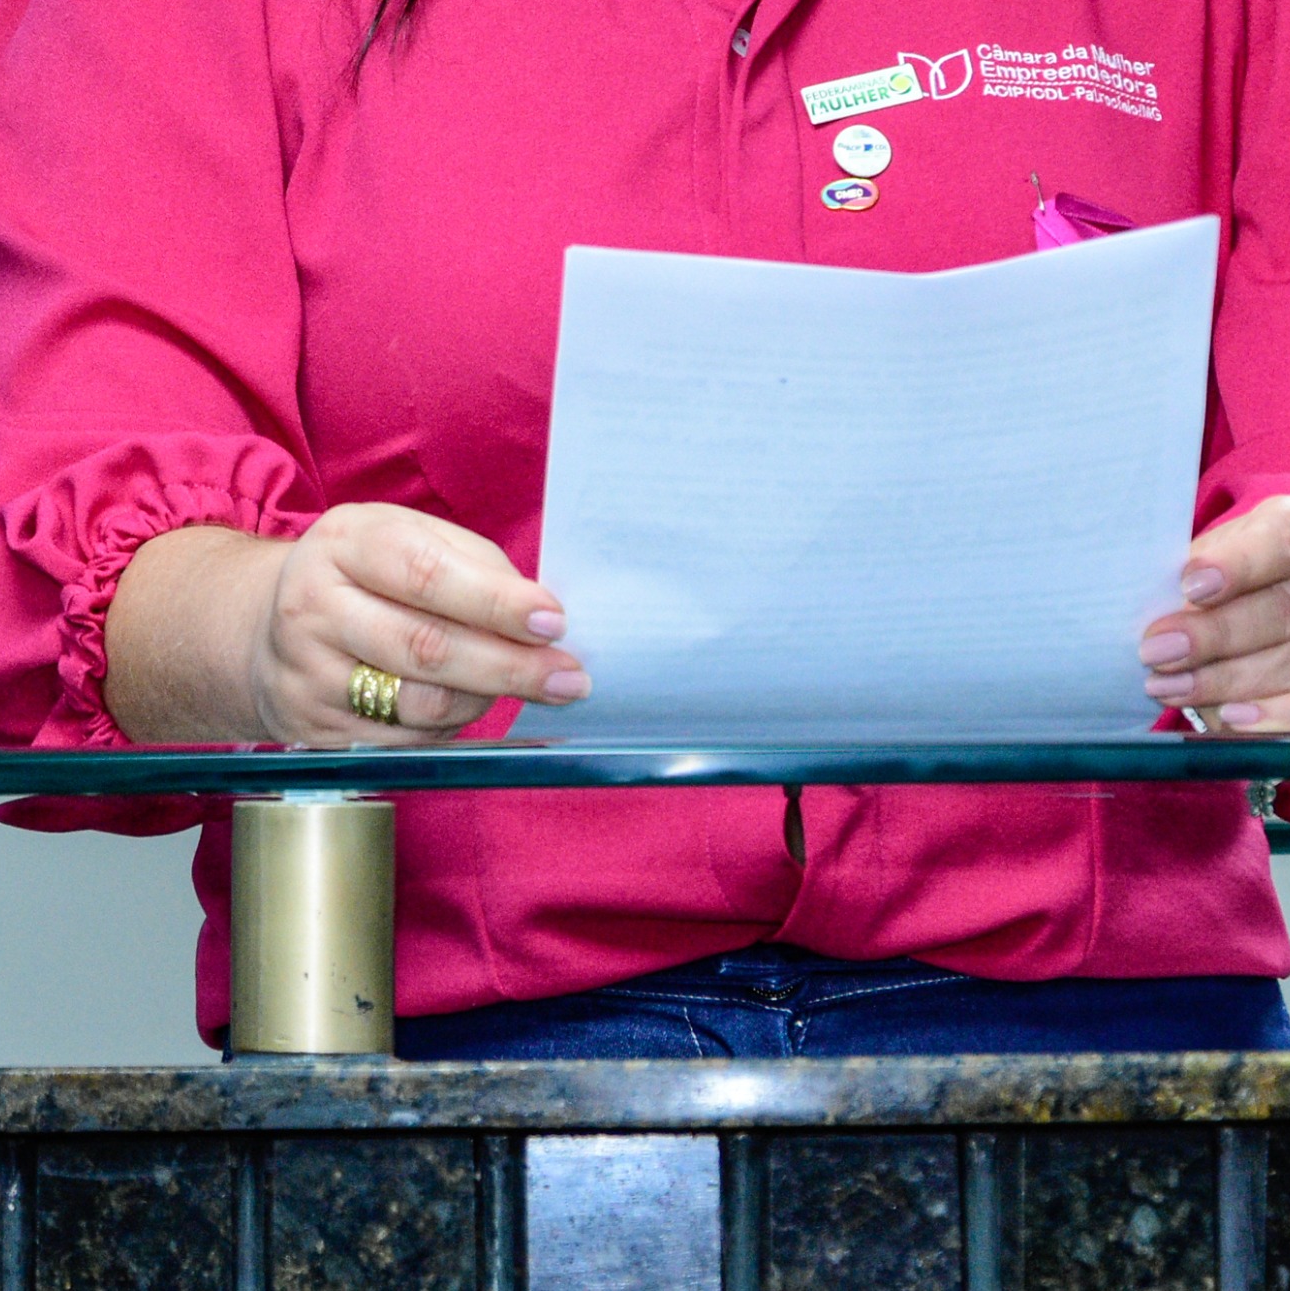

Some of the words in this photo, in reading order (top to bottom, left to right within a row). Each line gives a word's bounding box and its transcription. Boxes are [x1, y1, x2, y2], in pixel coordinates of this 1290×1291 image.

[976, 44, 1058, 65] Câmara
[1062, 44, 1090, 61] da
[1090, 43, 1155, 77] Mulher
[805, 76, 887, 103] FEDERAMINAS
[980, 60, 1158, 99] Empreendedora
[811, 87, 891, 116] MULHER
